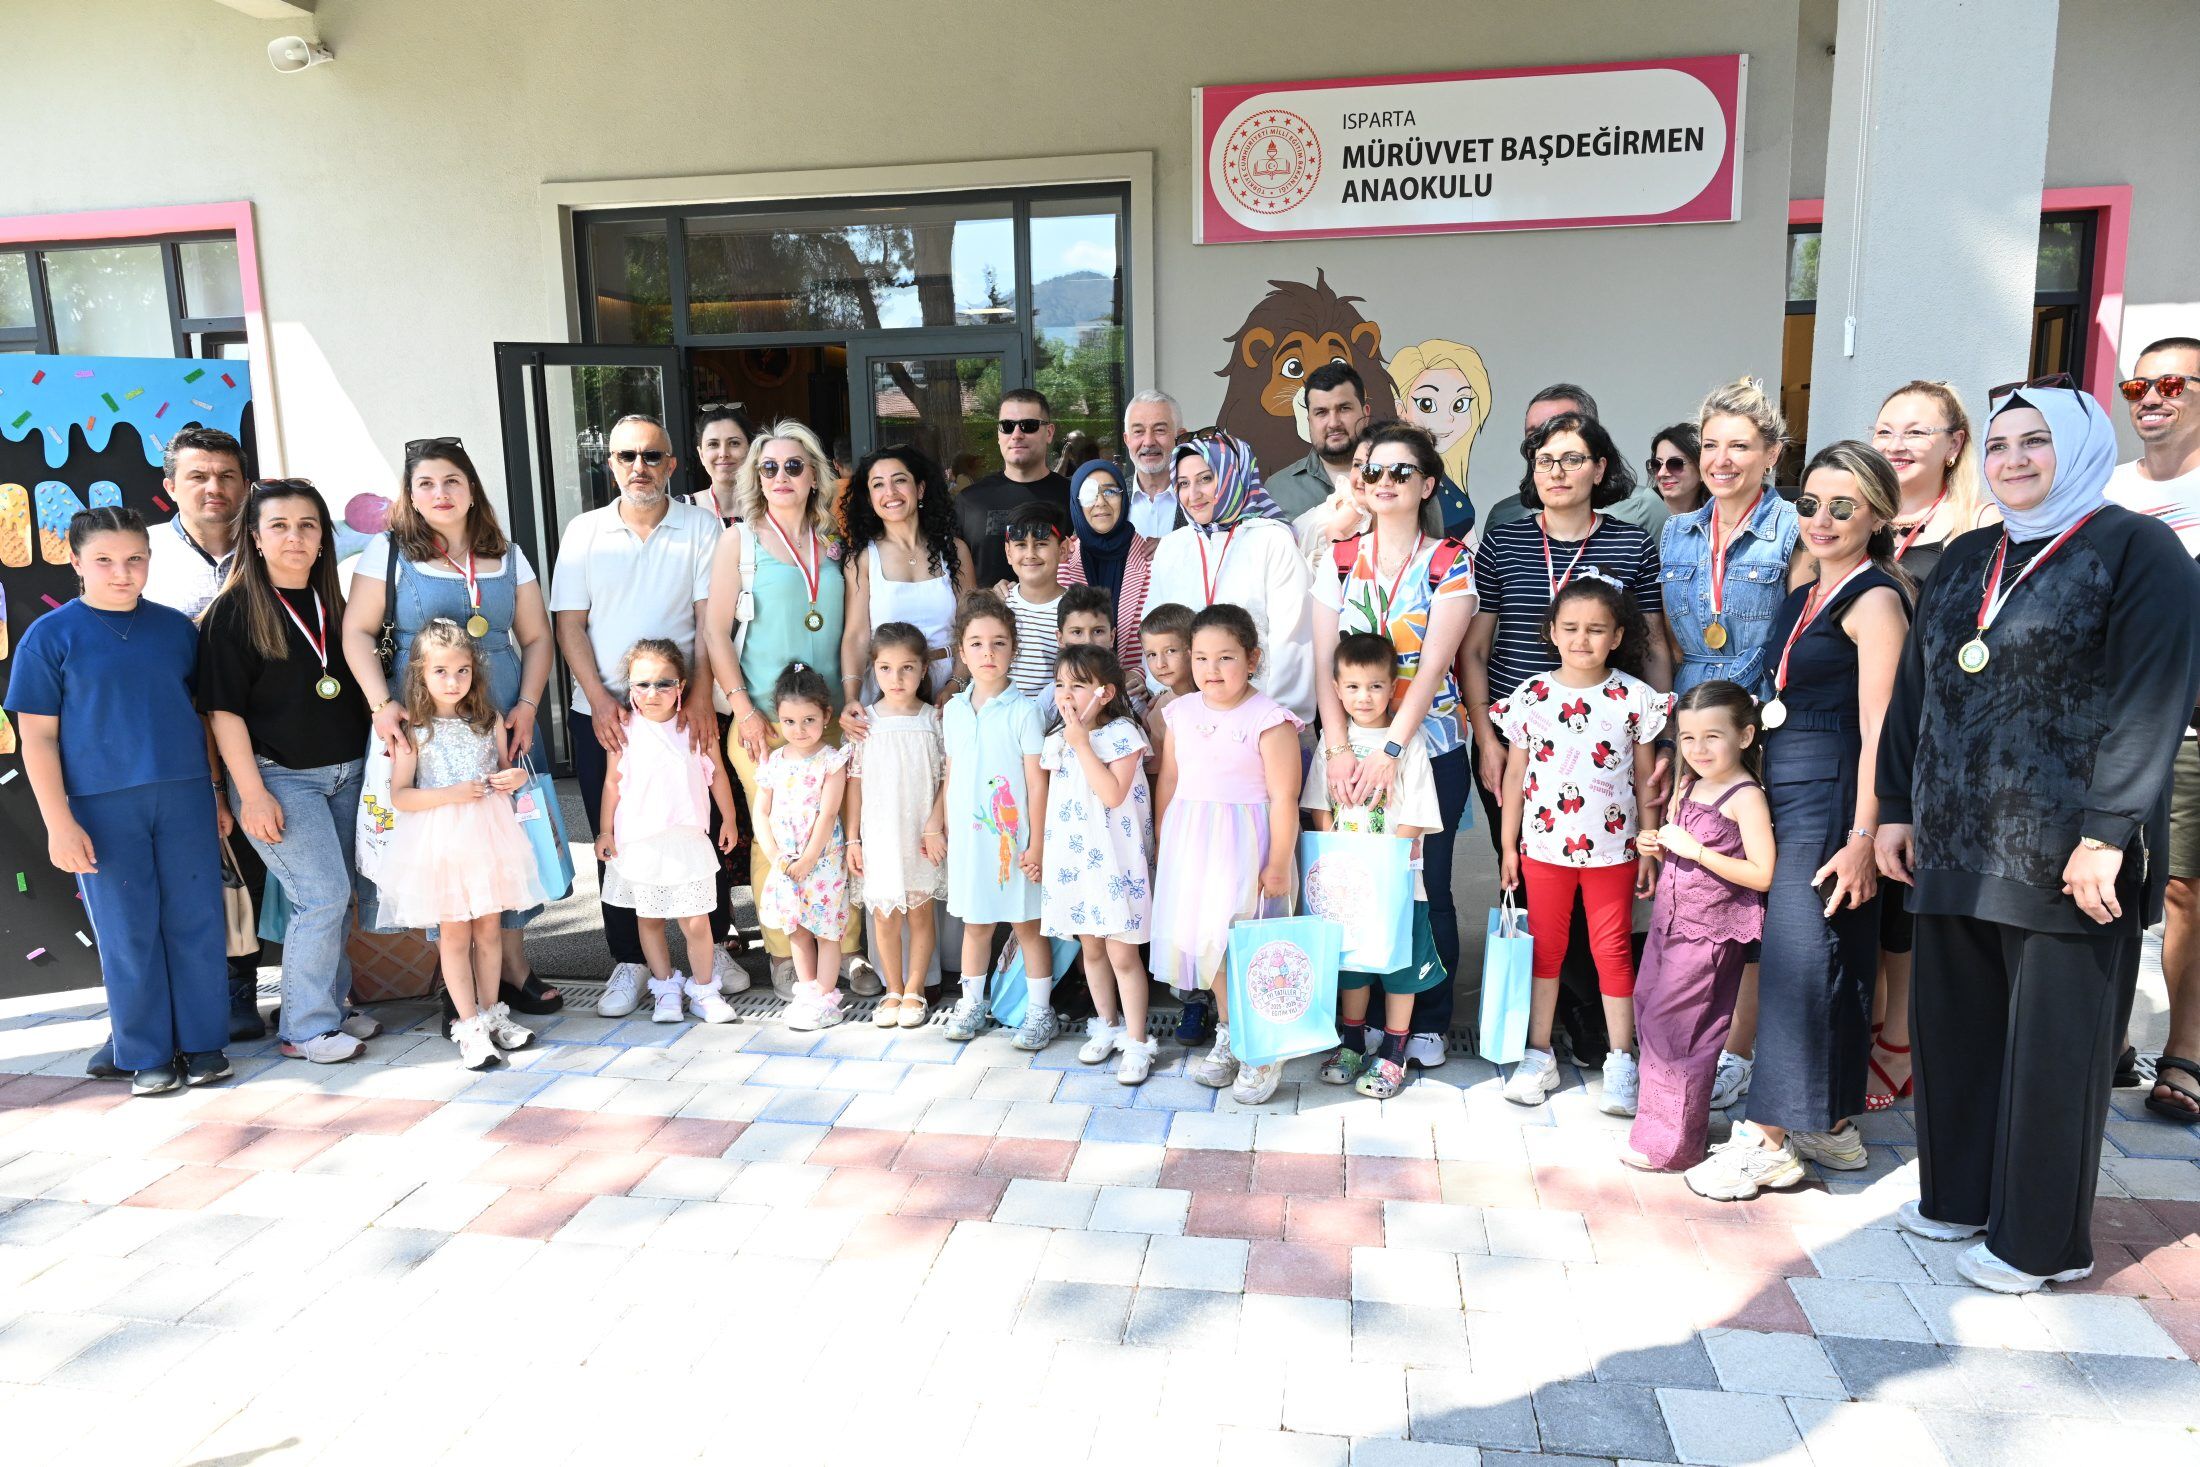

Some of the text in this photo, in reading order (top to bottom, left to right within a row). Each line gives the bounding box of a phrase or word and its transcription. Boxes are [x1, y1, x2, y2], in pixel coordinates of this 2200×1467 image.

[1343, 110, 1416, 130] ISPARTA
[1242, 129, 1268, 171] CUMHURİYETİ
[1342, 126, 1704, 169] MÜRÜVVET BAŞDEĞİRMEN
[1242, 173, 1265, 195] TÜRKİYE
[1278, 161, 1304, 194] BAKANLIĞI
[1342, 173, 1492, 203] ANAOKULU
